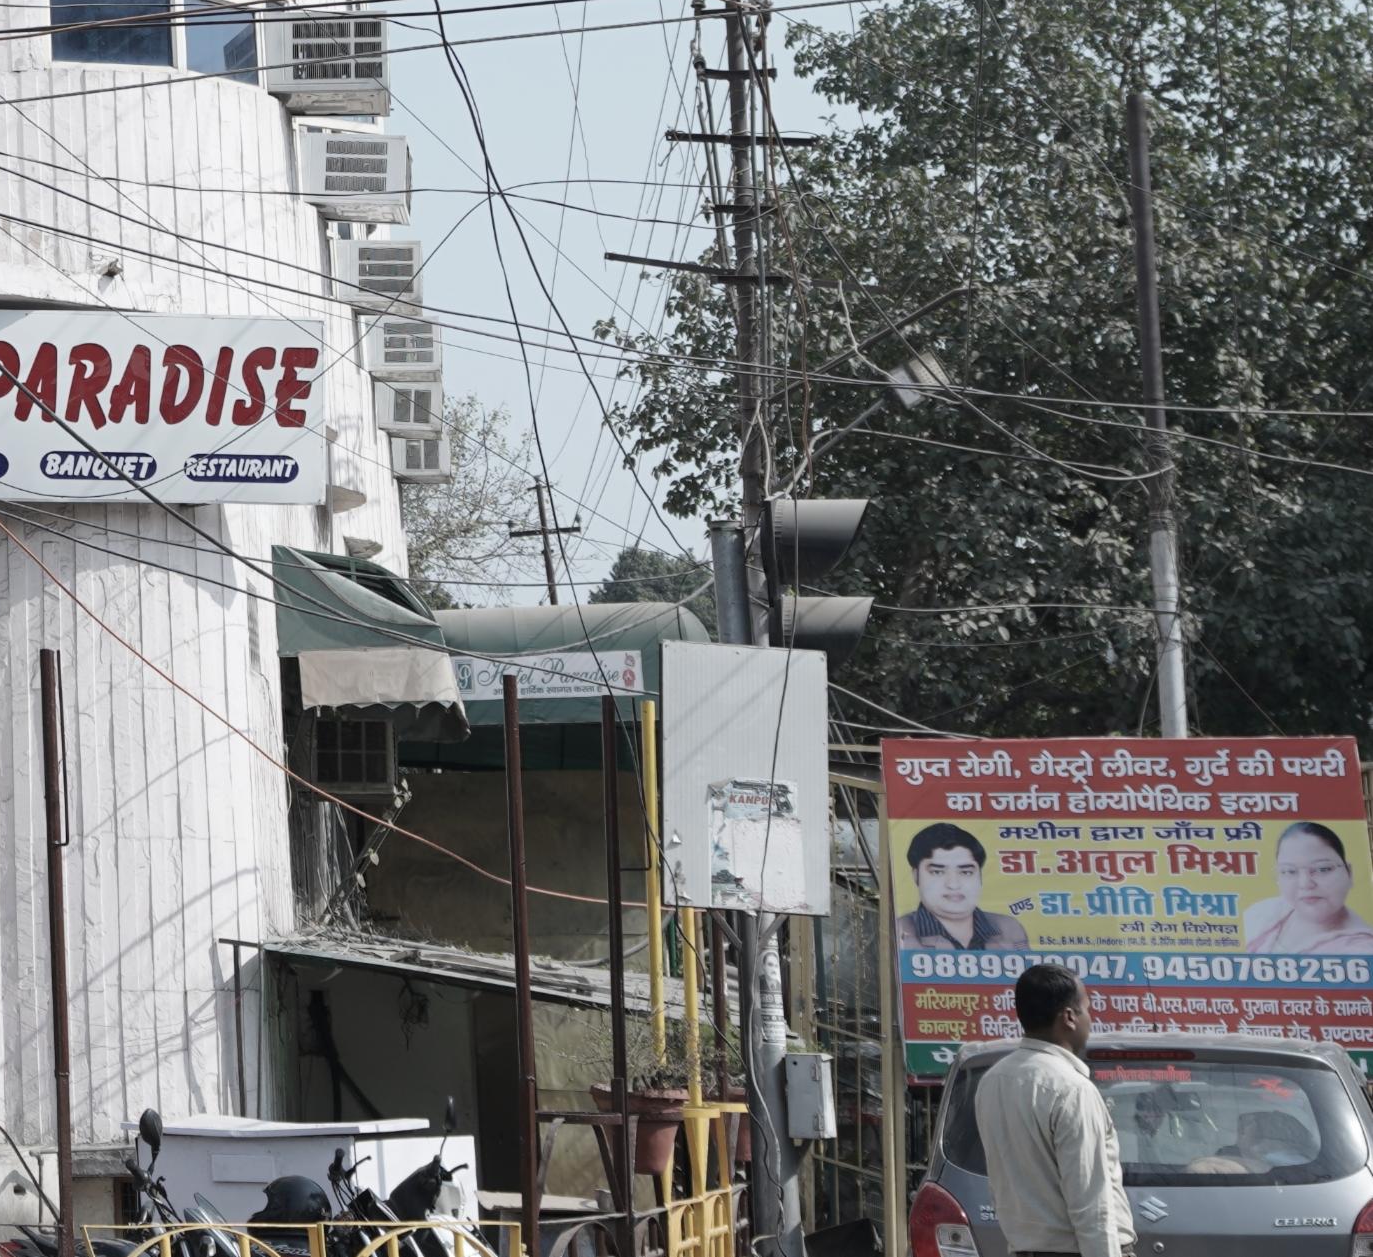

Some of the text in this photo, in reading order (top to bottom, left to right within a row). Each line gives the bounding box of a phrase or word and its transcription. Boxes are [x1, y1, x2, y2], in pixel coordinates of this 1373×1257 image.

[45, 451, 151, 480] BANQUET
[184, 454, 296, 479] RESTAURANT
[477, 660, 533, 687] Htel
[541, 657, 618, 685] Paradise
[896, 749, 1347, 786] गुप्त रोगी, गैस्ट्रो लीवर, गुर्दे की पथरी
[946, 783, 1300, 814] का जर्मन होम्योपैथिक इलाज
[998, 822, 1264, 842] मशीन द्वारा जाँच फ्री
[1167, 844, 1259, 877] मिश्रा
[1008, 898, 1035, 916] एण्ड
[1087, 886, 1156, 918] प्रीति
[1164, 887, 1239, 918] मिश्रा
[1120, 921, 1239, 935] स्त्री रोग विशेषज्ञ
[1143, 954, 1371, 983] 9450768256
[1091, 991, 1107, 1012] के
[1110, 994, 1140, 1013] पास
[1315, 995, 1330, 1016] के
[1332, 995, 1373, 1016] सामने
[919, 1018, 968, 1040] कानपुर
[1275, 1216, 1338, 1228] CELERIO
